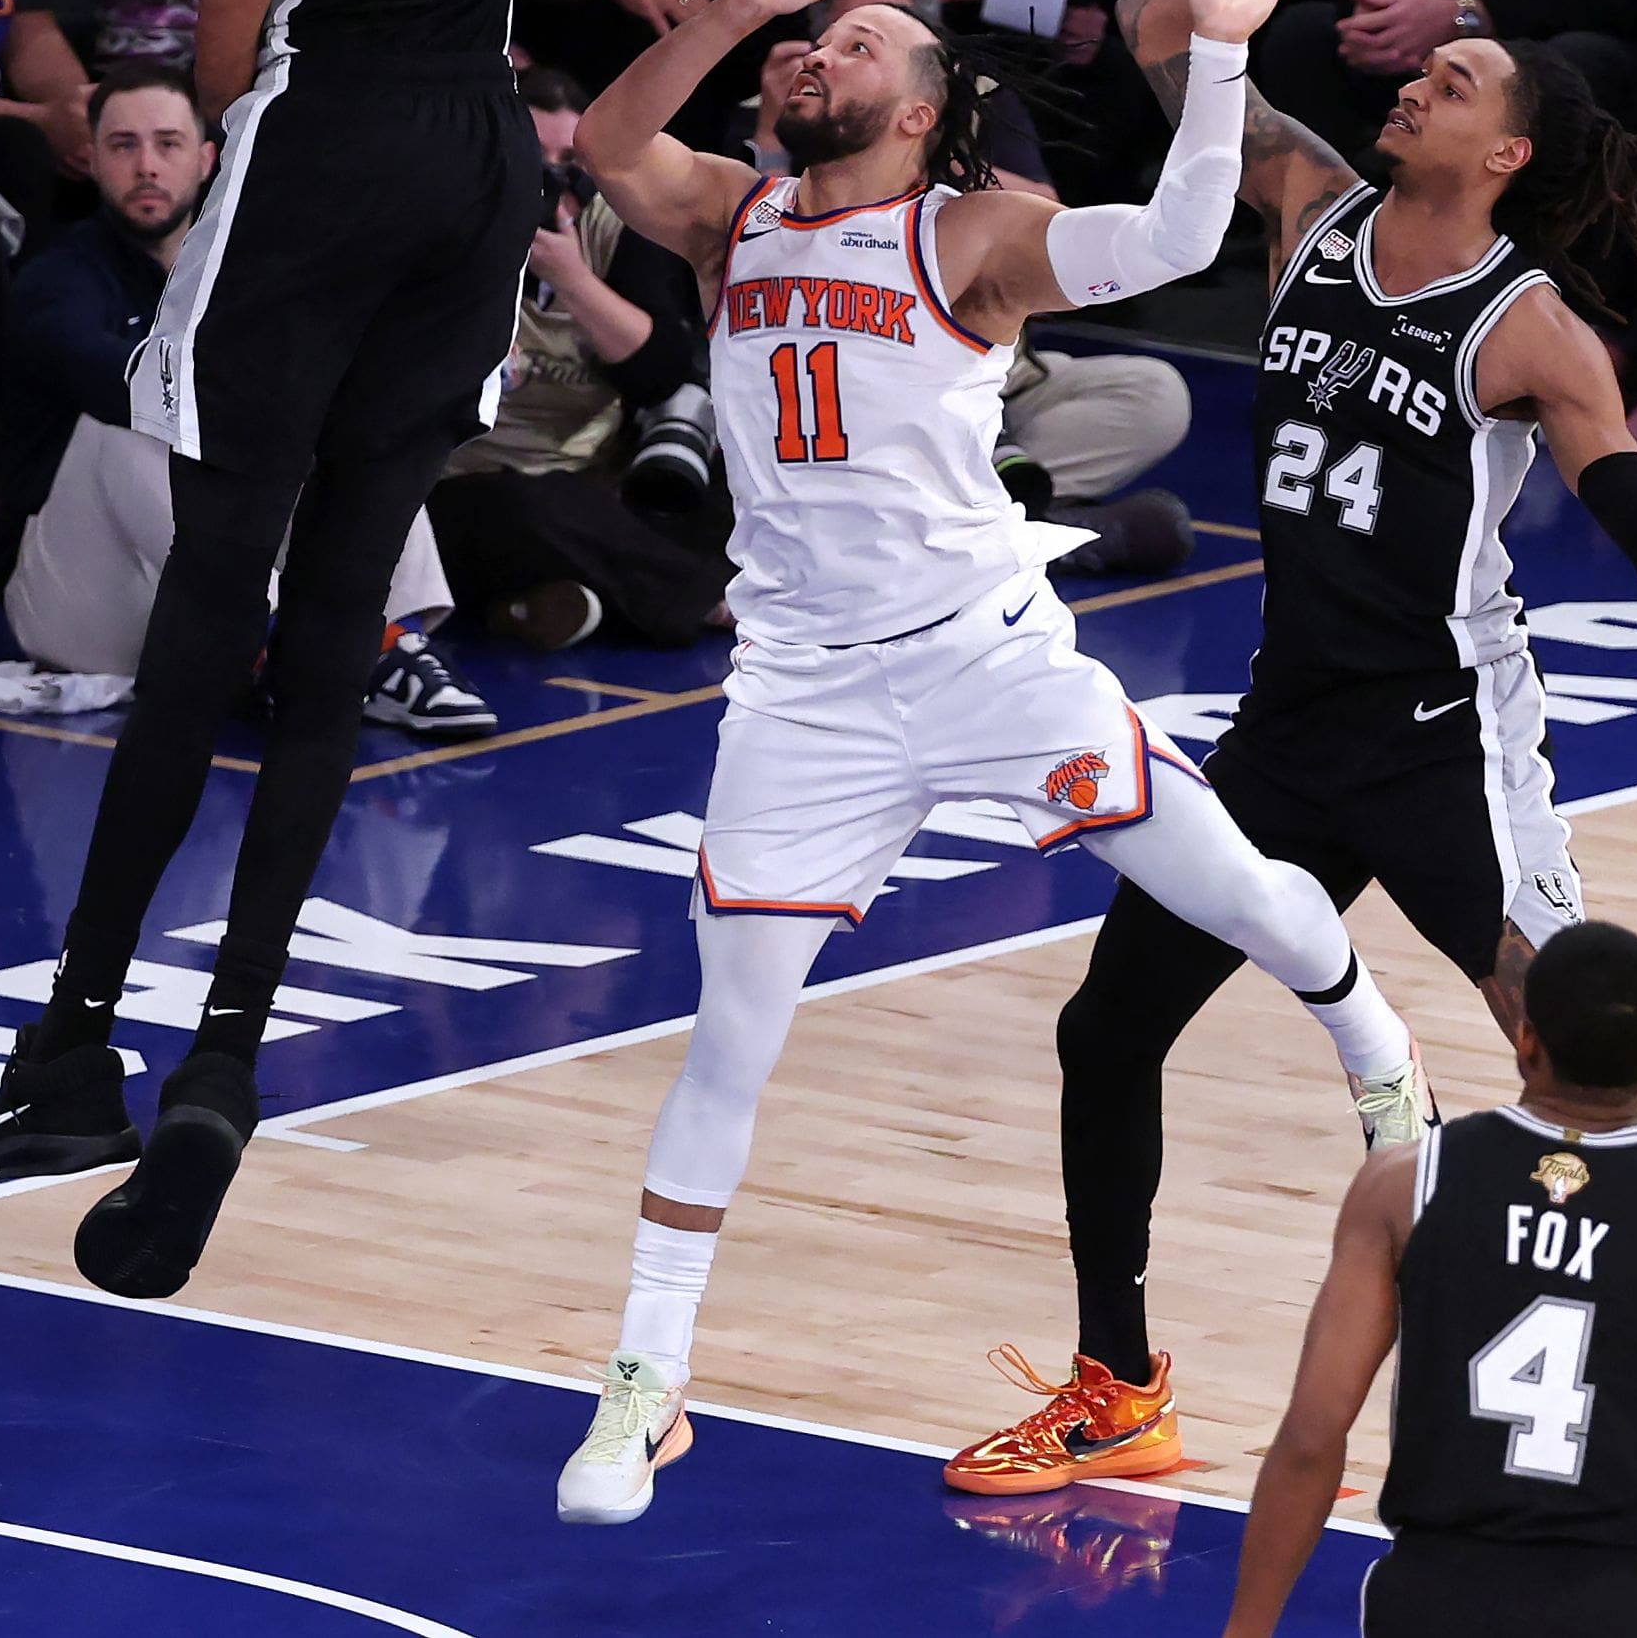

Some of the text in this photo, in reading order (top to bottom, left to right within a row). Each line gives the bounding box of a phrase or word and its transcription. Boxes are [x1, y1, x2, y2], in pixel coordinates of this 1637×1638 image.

[840, 236, 899, 251] abu dhabi
[727, 276, 916, 347] NEW YORK
[1400, 322, 1443, 345] LEDGER
[770, 341, 849, 464] 11
[1263, 325, 1447, 437] SPURS
[1263, 418, 1384, 536] 24
[1046, 752, 1111, 803] KNICKS
[1540, 1158, 1589, 1179] Finals
[1506, 1204, 1610, 1283] FOX
[1468, 1294, 1596, 1486] 4
